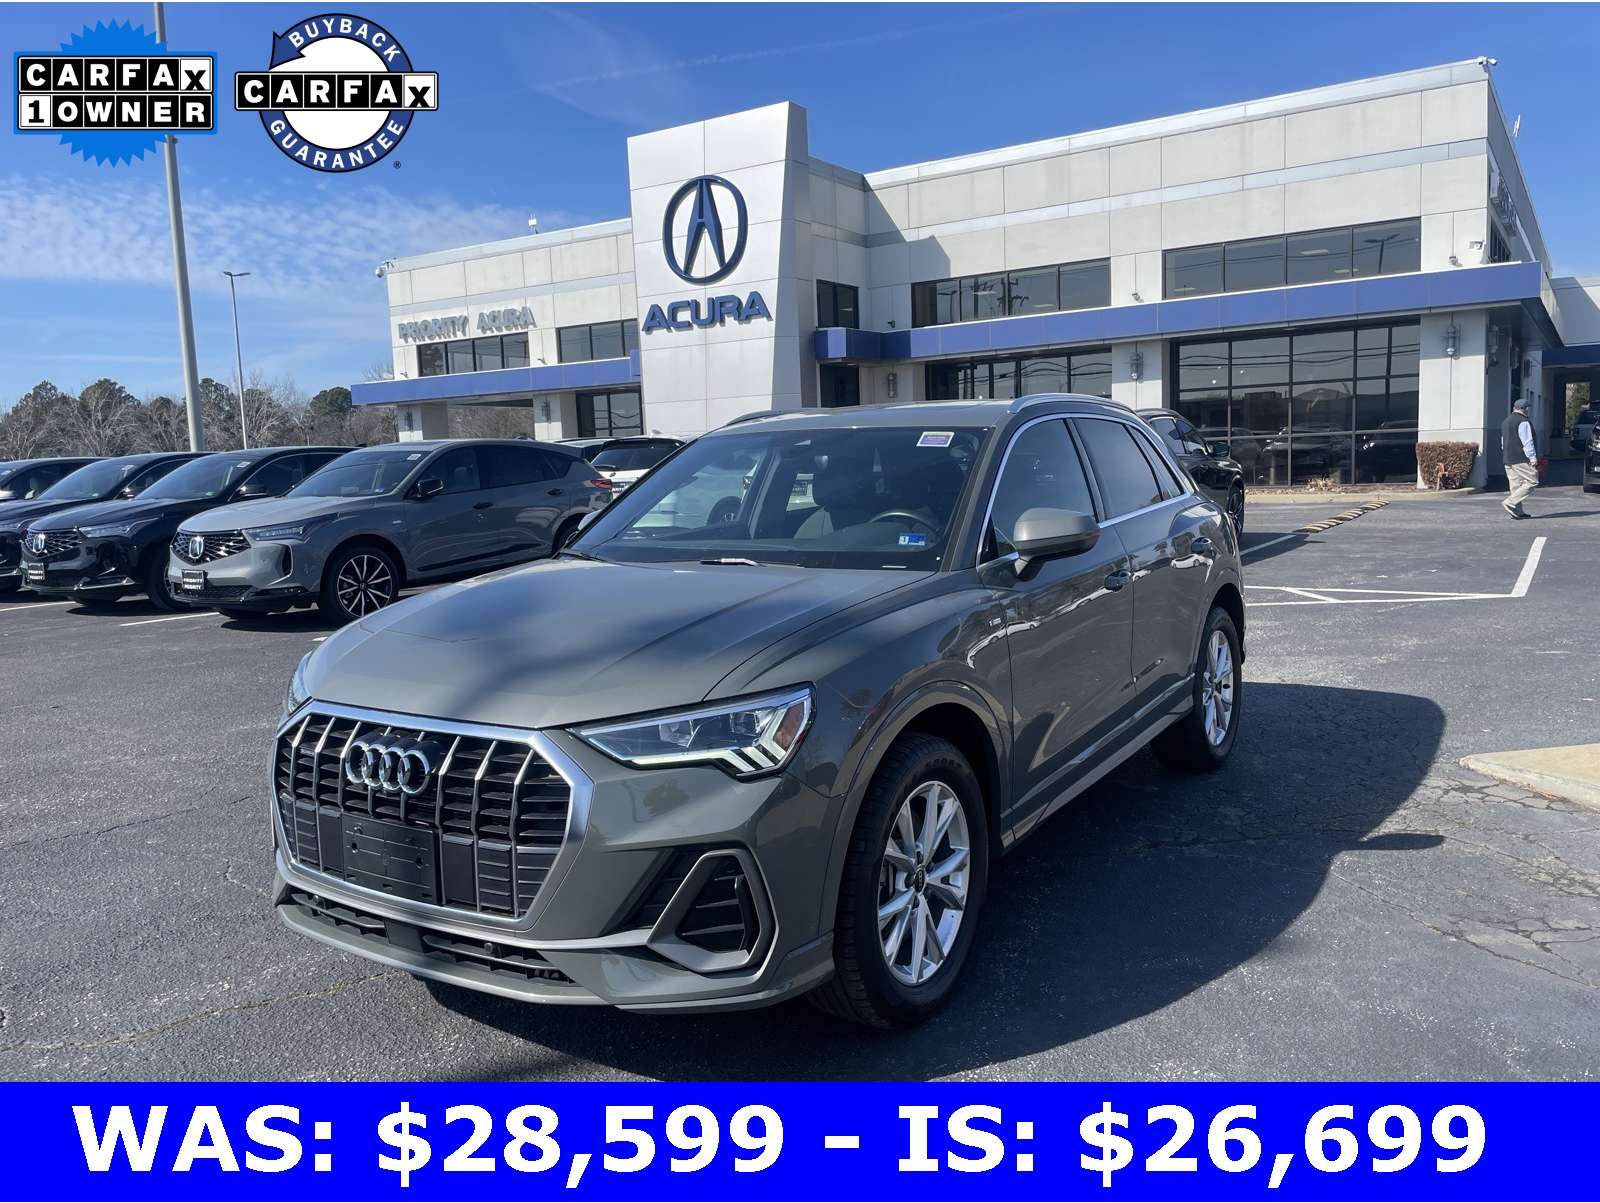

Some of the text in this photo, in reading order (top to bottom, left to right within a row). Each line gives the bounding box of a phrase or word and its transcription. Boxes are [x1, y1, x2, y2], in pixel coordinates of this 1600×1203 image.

[398, 305, 537, 344] PRIORITY ACURA
[641, 291, 774, 334] ACURA
